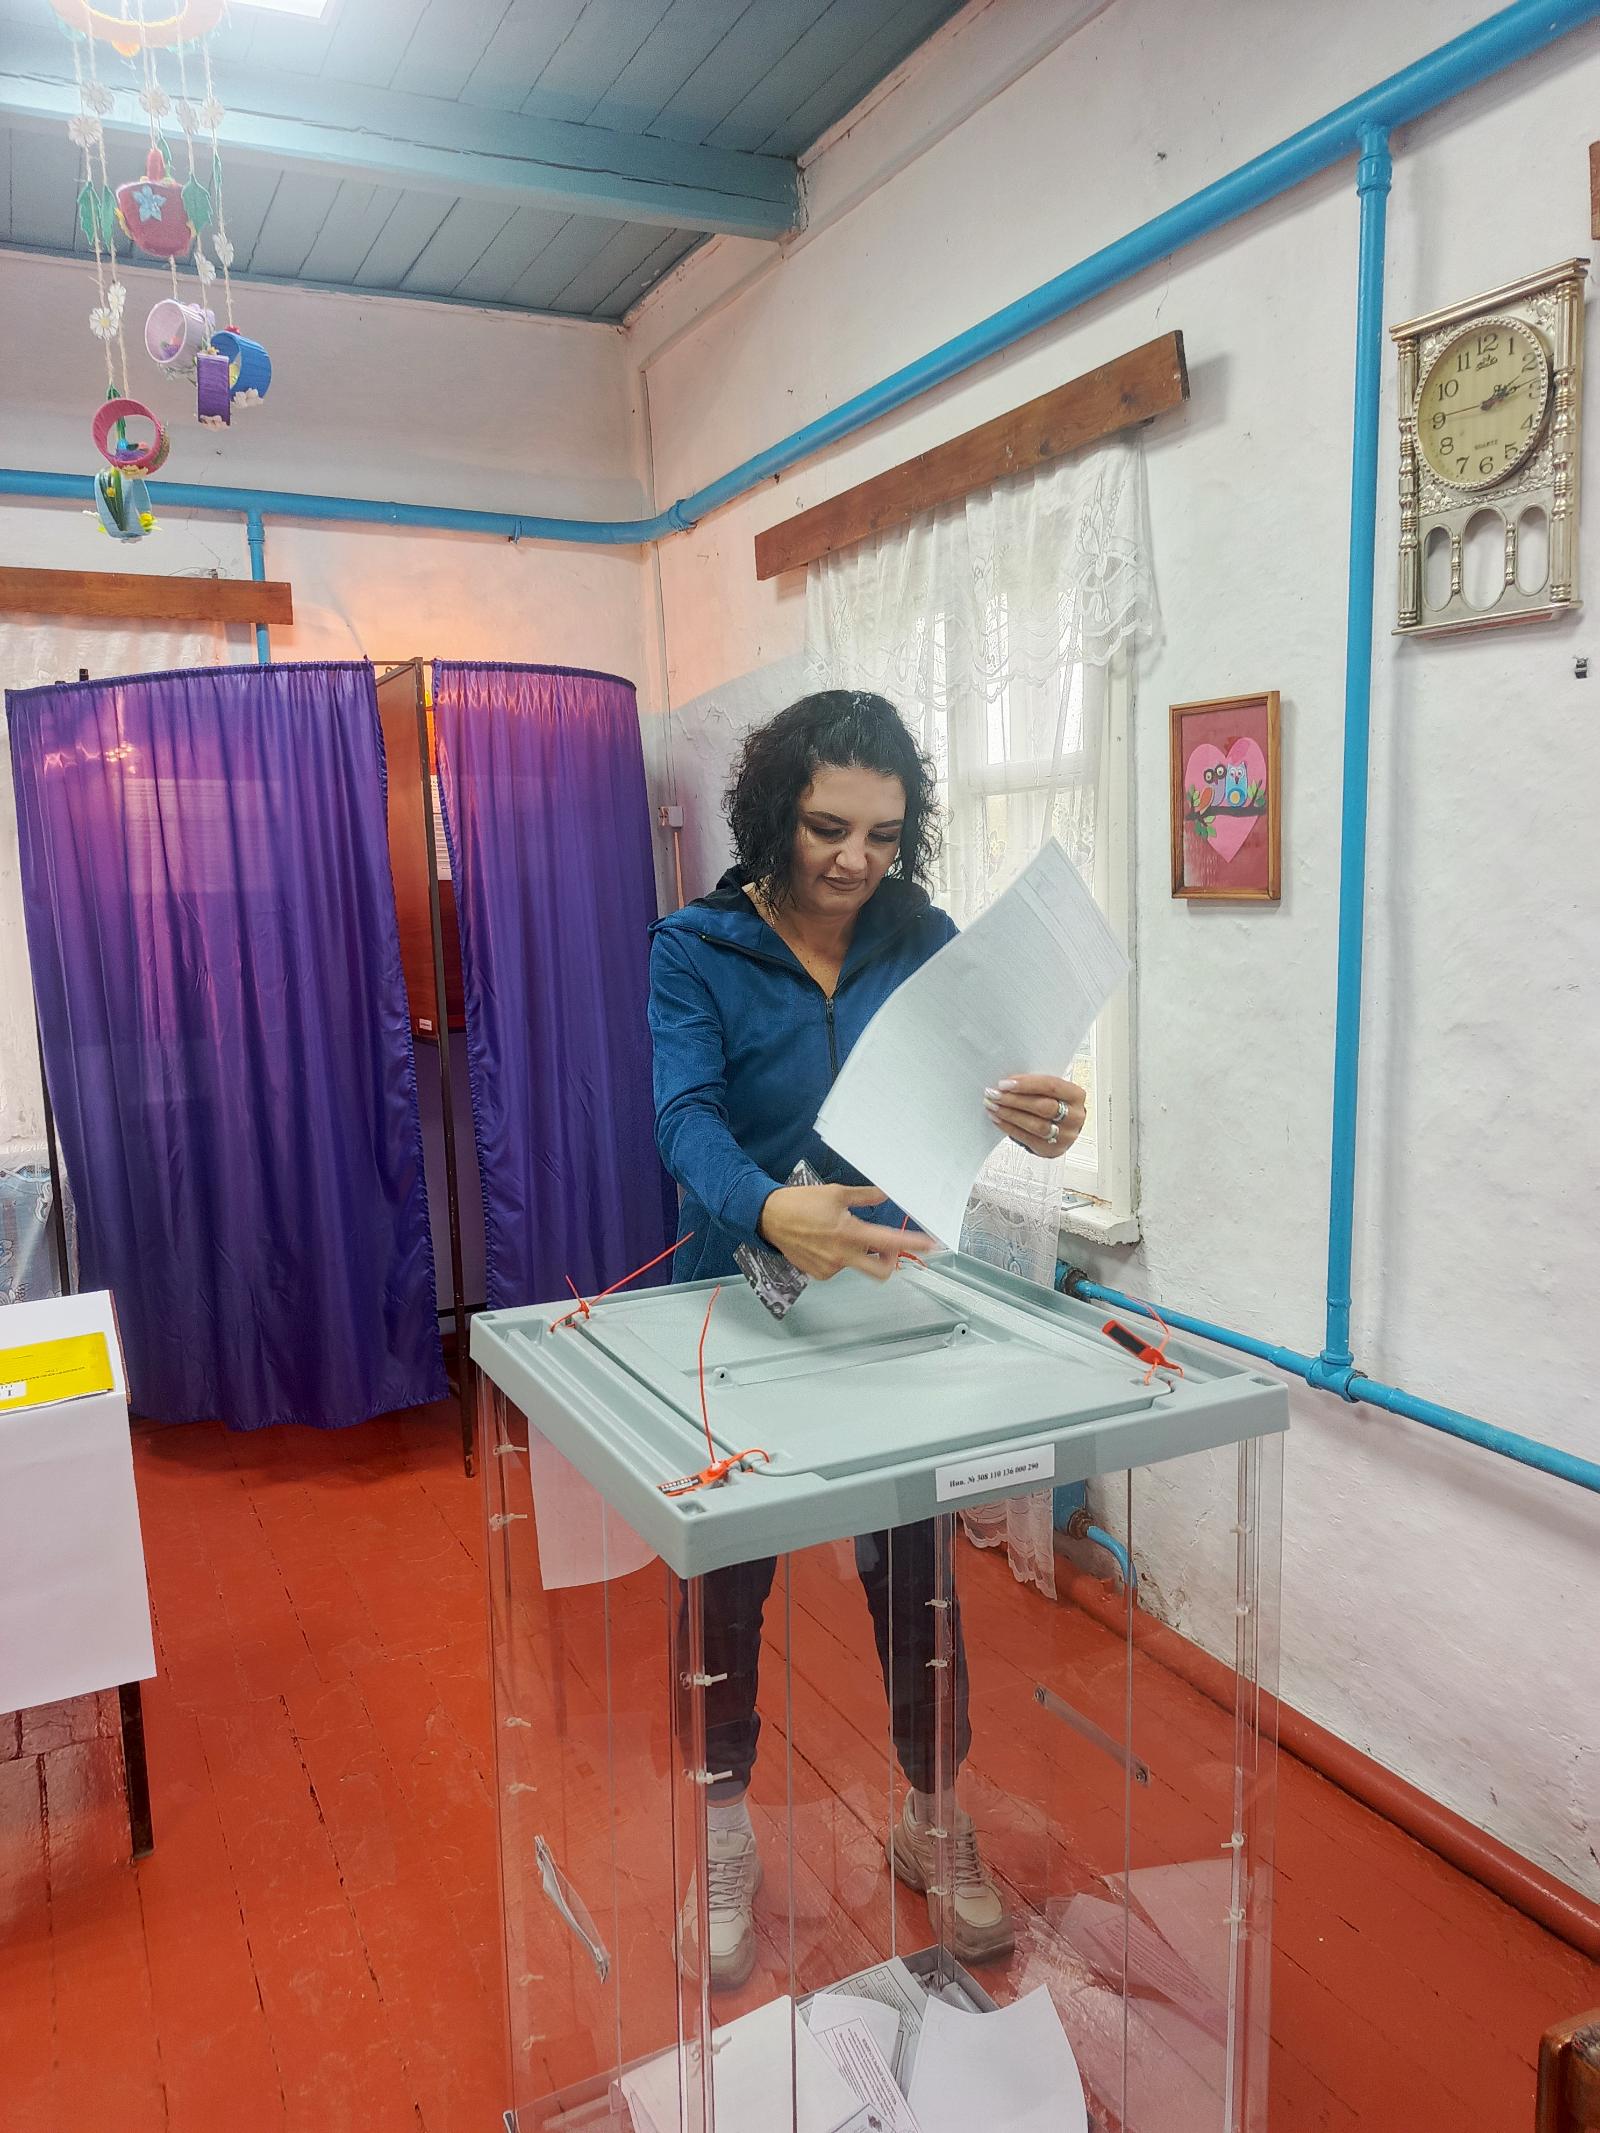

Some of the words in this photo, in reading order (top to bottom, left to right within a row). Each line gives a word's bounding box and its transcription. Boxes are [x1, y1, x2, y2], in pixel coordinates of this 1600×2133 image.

[1476, 333, 1499, 356] 12
[1508, 337, 1515, 356] 1
[1457, 352, 1470, 373] 11
[1521, 352, 1537, 373] 2
[1438, 379, 1459, 401] 10
[1432, 412, 1446, 430] 9
[1520, 413, 1533, 431] 4
[1439, 436, 1454, 456] 8
[1504, 441, 1519, 460] 5
[1456, 455, 1470, 475] 7
[1479, 456, 1494, 475] 6
[977, 1473, 989, 1482] 308
[990, 1470, 1001, 1479] 110
[1003, 1467, 1014, 1477] 136
[1015, 1464, 1026, 1473] 000
[1028, 1462, 1038, 1471] 290
